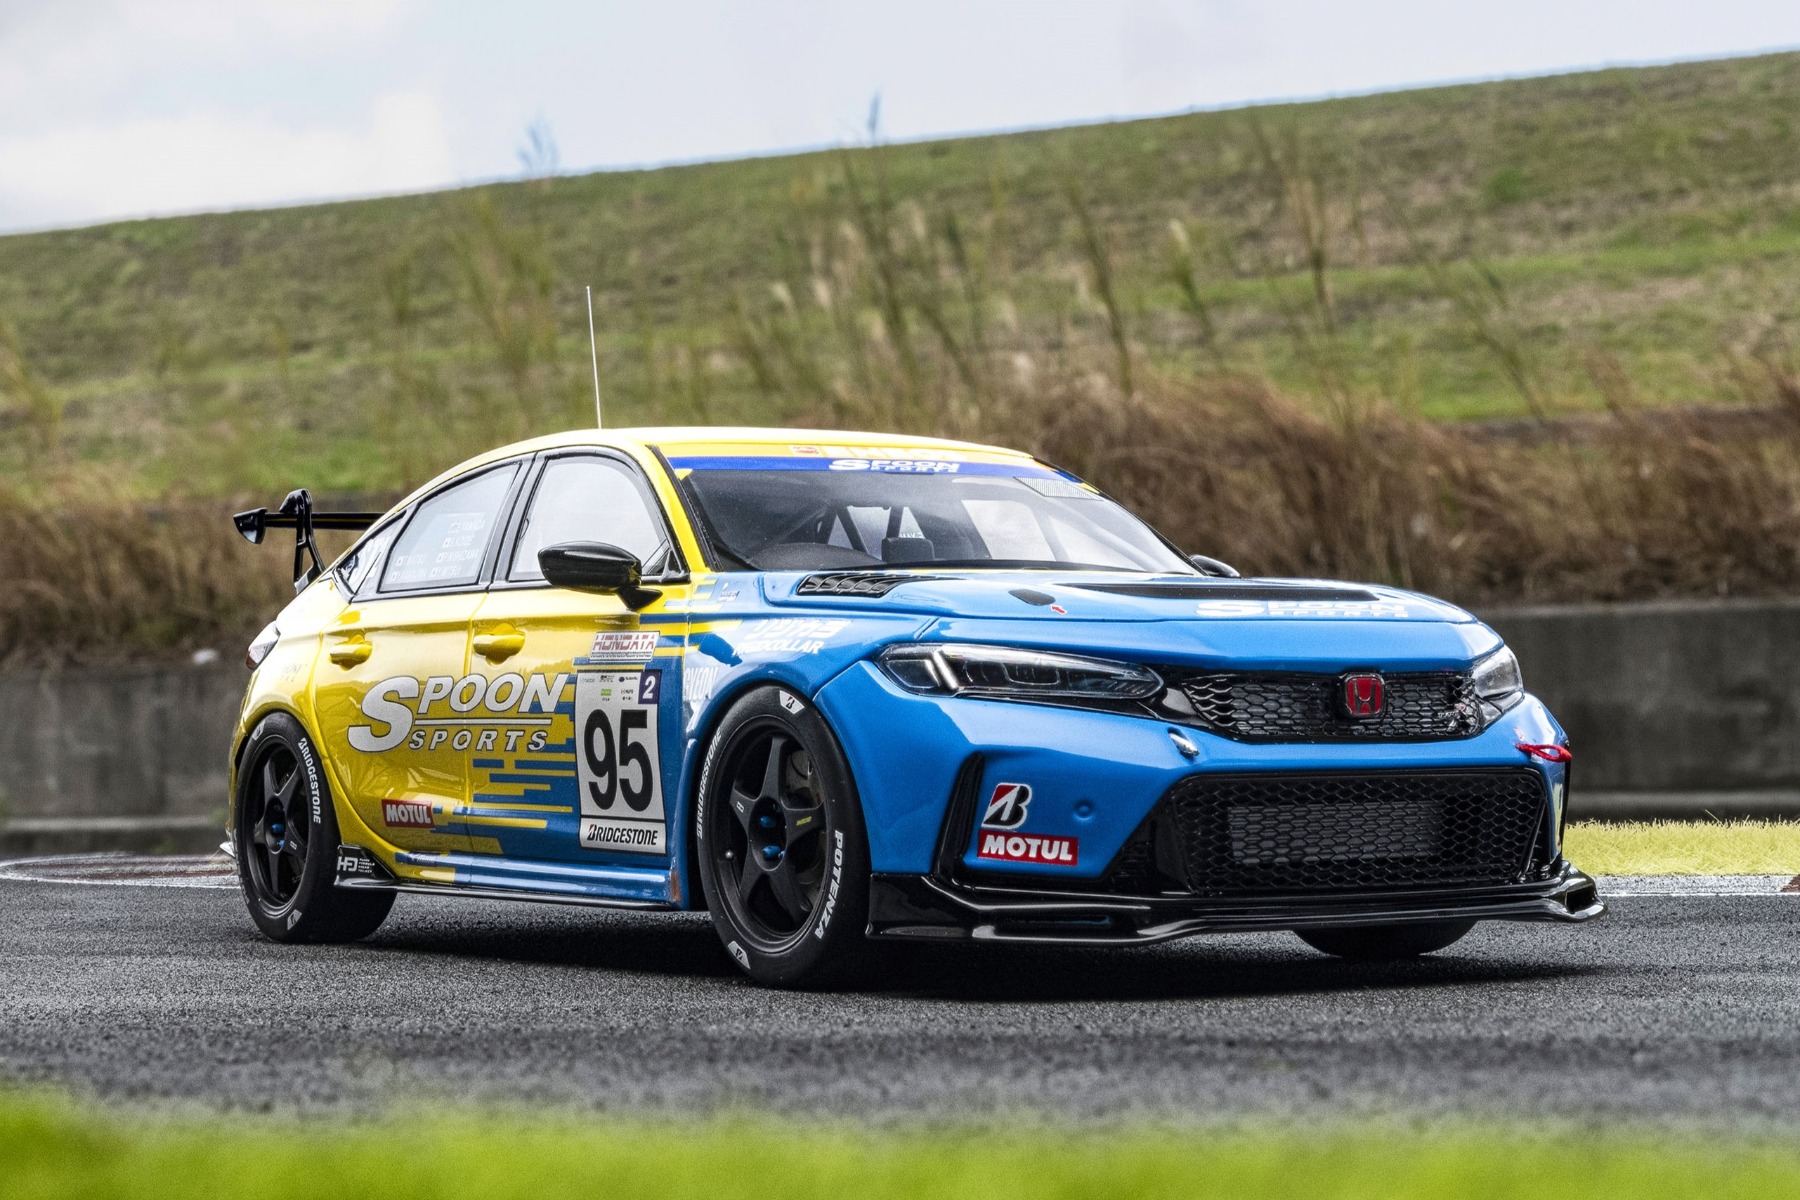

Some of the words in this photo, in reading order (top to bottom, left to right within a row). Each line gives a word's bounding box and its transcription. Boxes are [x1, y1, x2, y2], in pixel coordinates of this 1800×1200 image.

[828, 459, 960, 473] SPOON
[1195, 601, 1405, 617] SPOON
[642, 675, 656, 699] 2
[347, 672, 571, 752] SPOON
[408, 729, 548, 752] SPORTS
[584, 708, 653, 812] 95
[297, 737, 322, 824] BRIDGESTONE
[697, 726, 723, 840] BRIDGESTONE
[385, 803, 432, 824] MOTUL
[587, 823, 659, 846] BRIDGESTONE
[982, 834, 1073, 861] MOTUL
[814, 829, 844, 940] POTENZA
